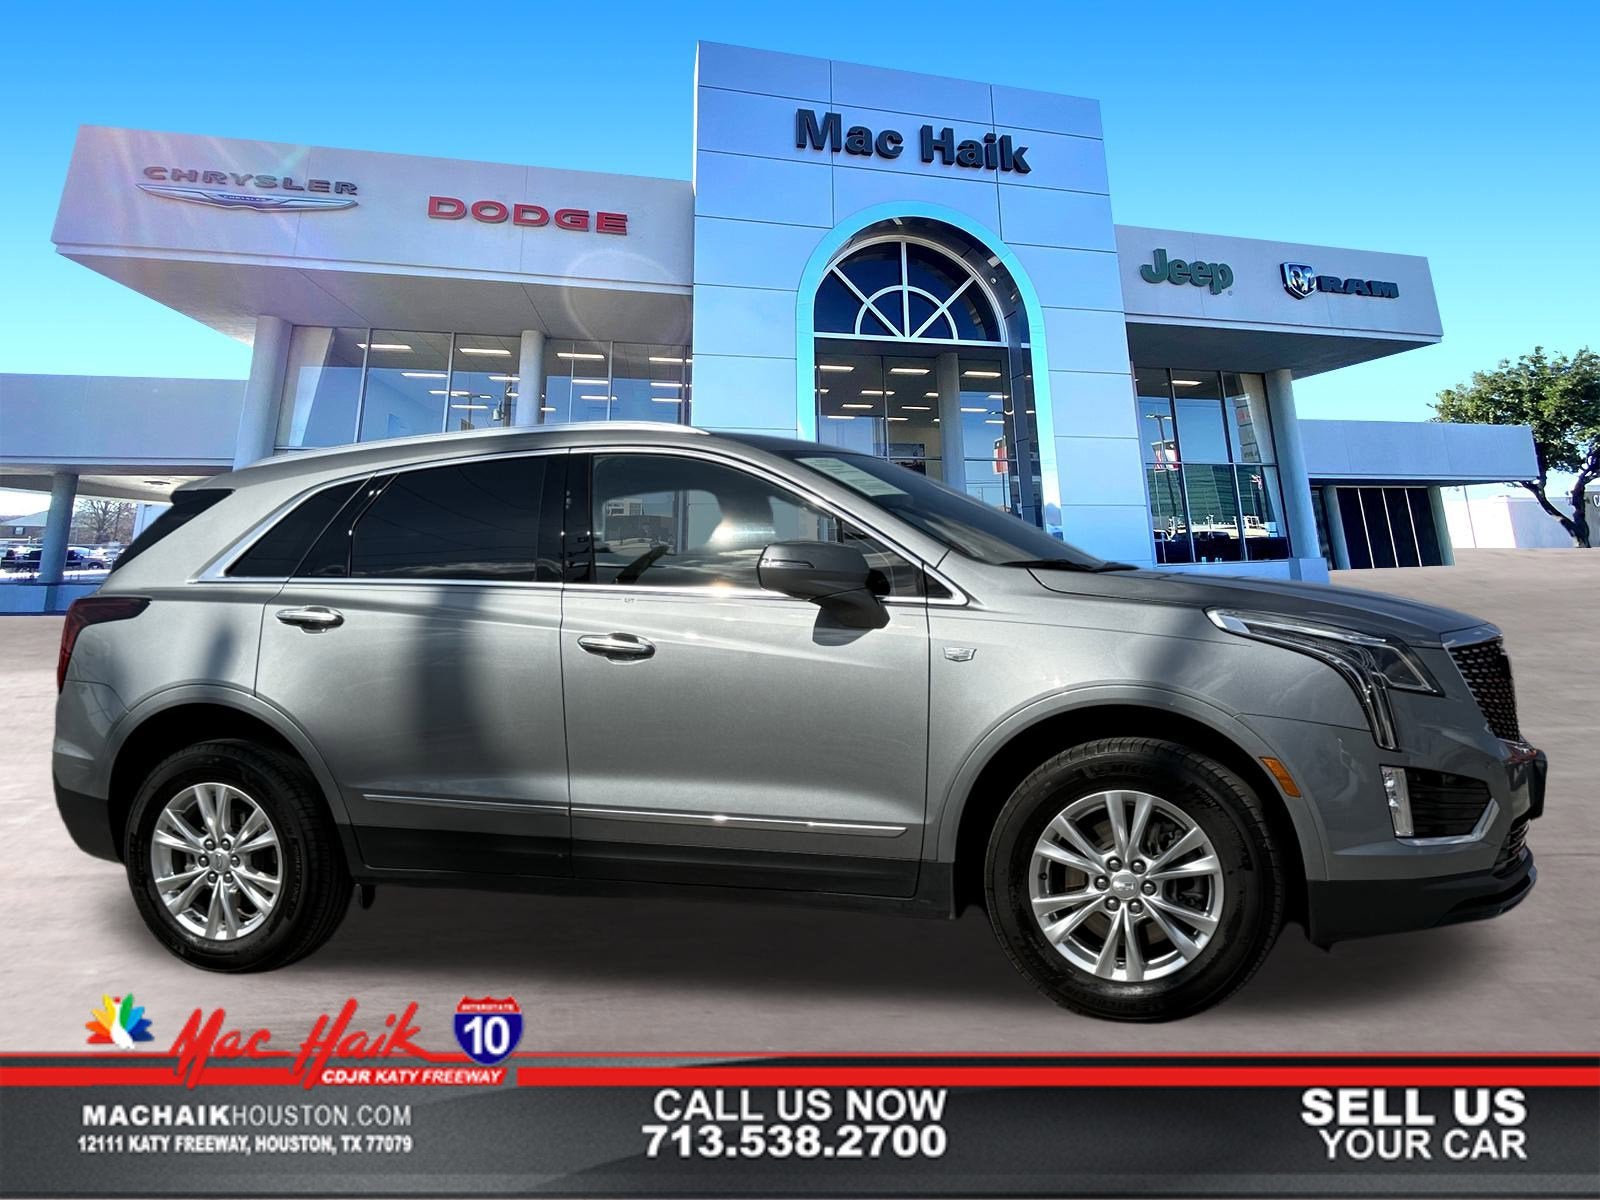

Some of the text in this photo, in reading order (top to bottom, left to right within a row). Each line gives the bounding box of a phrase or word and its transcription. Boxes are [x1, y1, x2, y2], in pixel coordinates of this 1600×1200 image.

[796, 108, 1032, 174] Mac Haik
[143, 166, 358, 196] CHRYSLER
[428, 195, 628, 236] DODGE
[1140, 248, 1234, 295] Jeep
[1316, 275, 1400, 299] RAM
